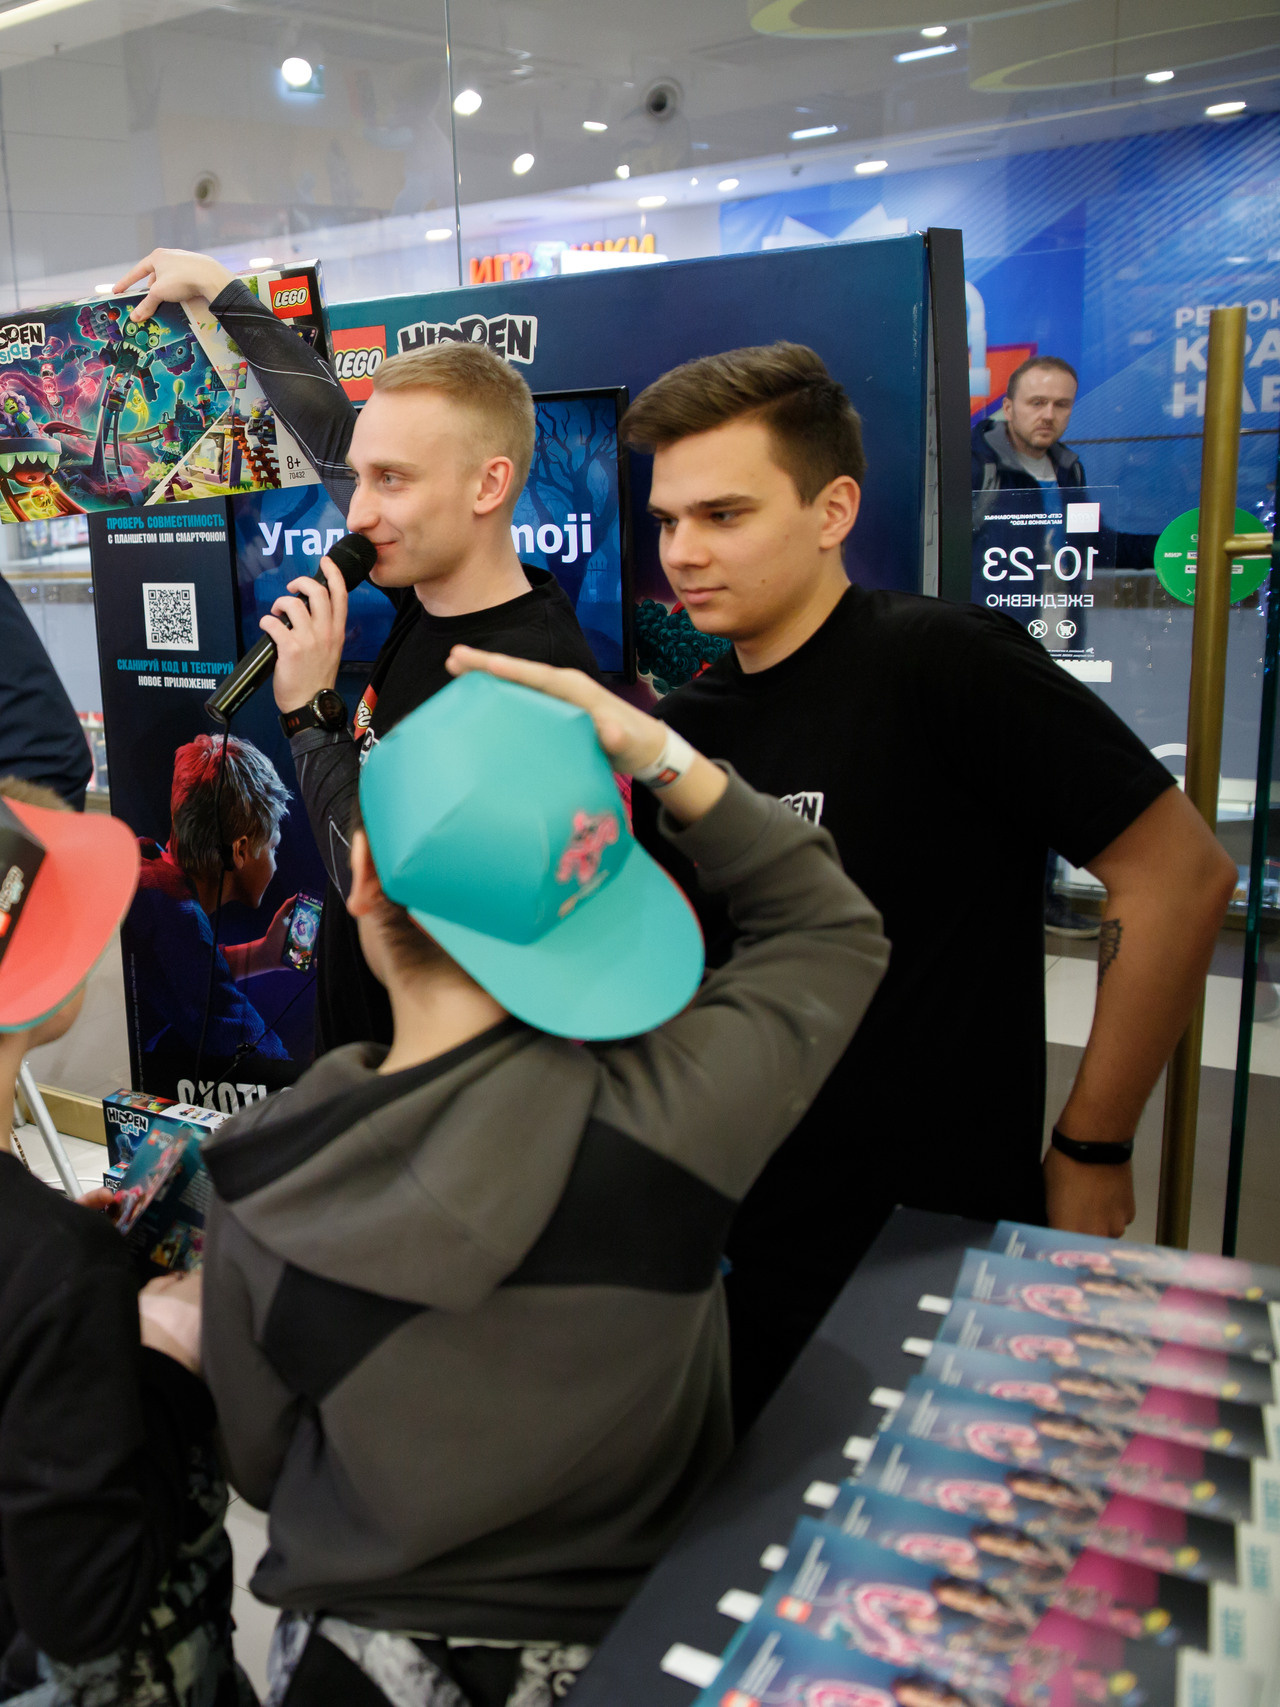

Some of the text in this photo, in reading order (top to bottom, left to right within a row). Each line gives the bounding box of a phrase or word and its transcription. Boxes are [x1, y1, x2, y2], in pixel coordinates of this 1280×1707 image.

[275, 288, 307, 308] LEGO
[334, 348, 384, 380] LEGO
[286, 455, 301, 470] 8+
[288, 470, 306, 480] 70432
[107, 514, 225, 530] ПРОВЕРЬ СОВМЕСТИМОСТЬ
[108, 531, 226, 544] С ПЛАНШЕТОМ ИЛИ СМАРТФОНОМ
[510, 513, 592, 563] moji
[117, 658, 234, 675] СКАНИРУЙ КОД И ТЕСТИРУЙ
[138, 675, 217, 690] НОВОЕ ПРИЛОЖЕНИЕ
[177, 1078, 294, 1116] ОХОТ
[107, 1107, 149, 1132] HIDDEN
